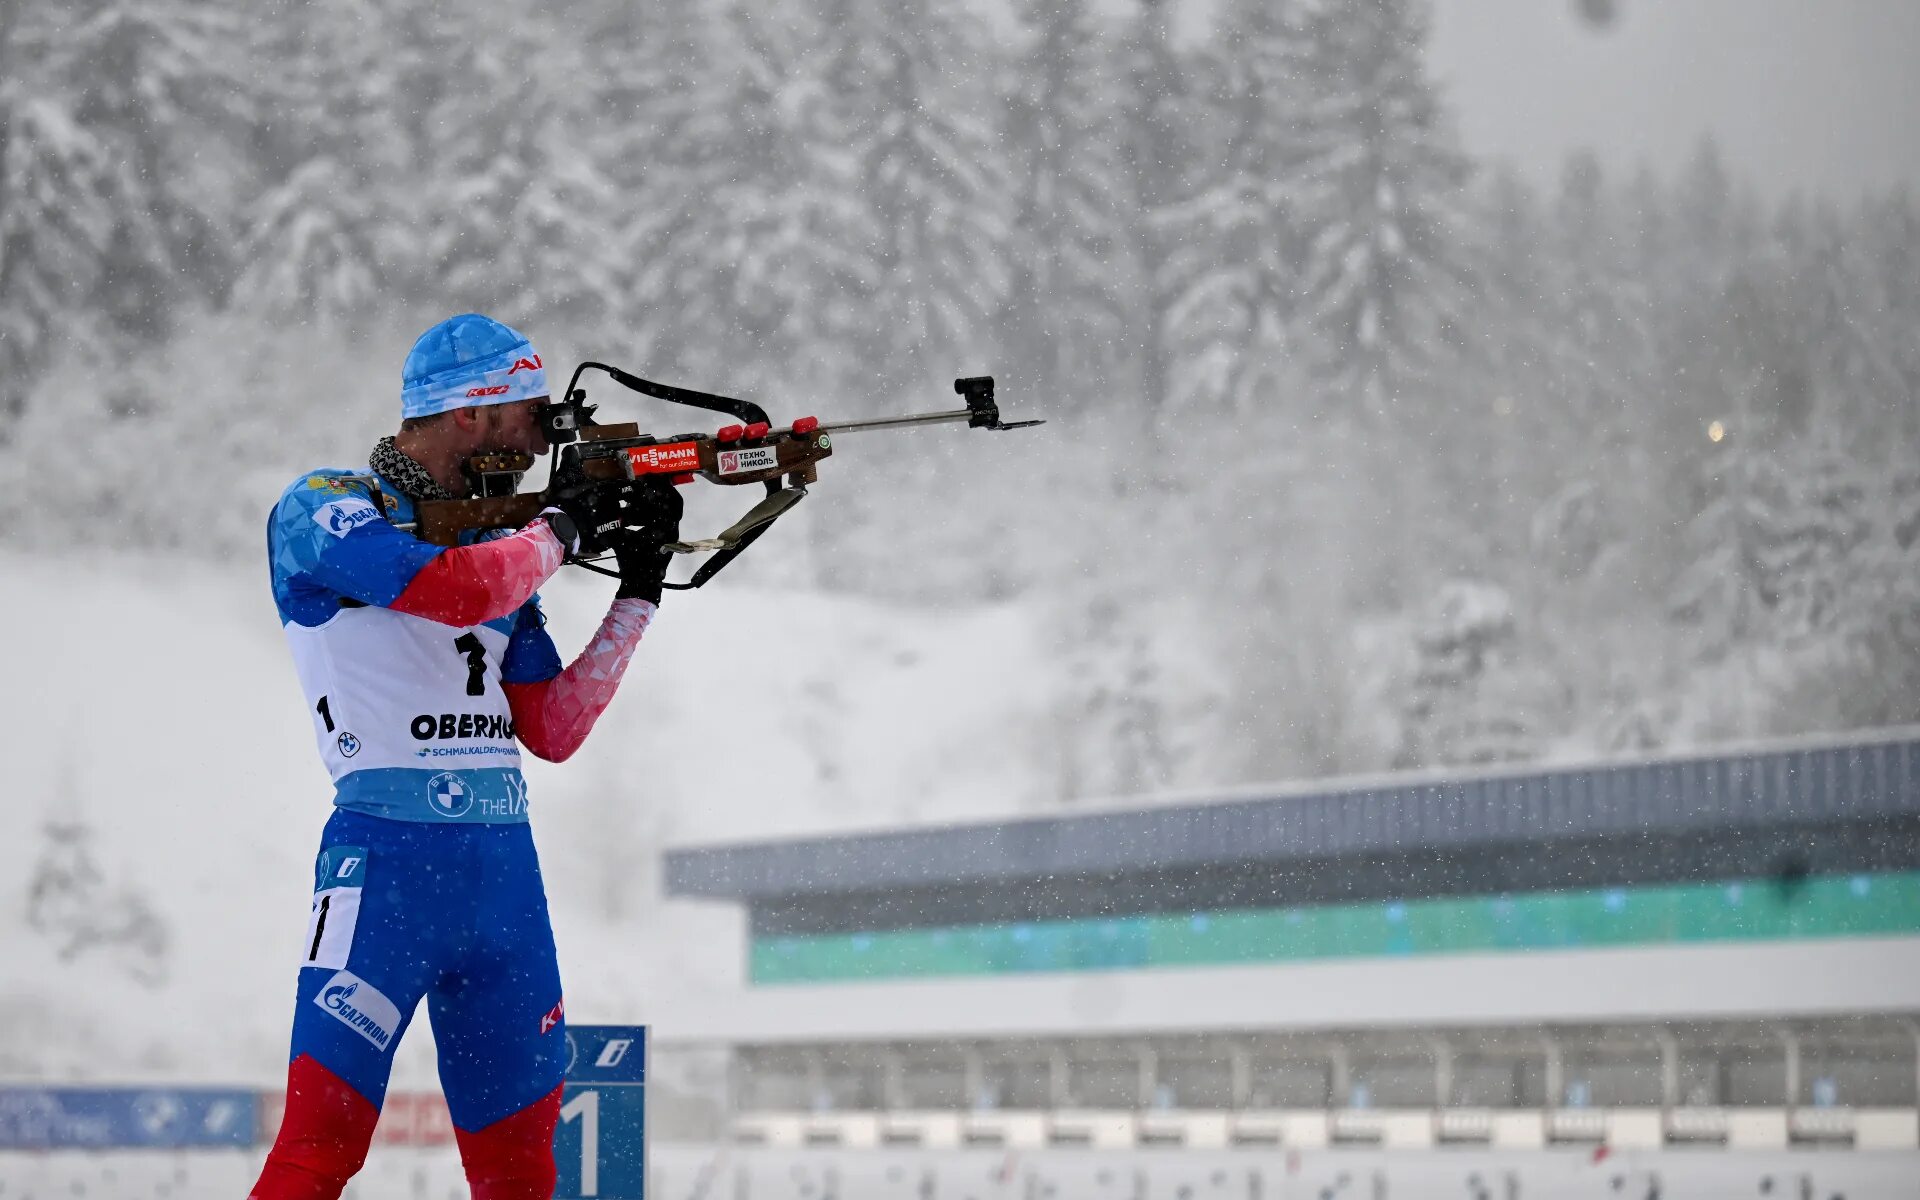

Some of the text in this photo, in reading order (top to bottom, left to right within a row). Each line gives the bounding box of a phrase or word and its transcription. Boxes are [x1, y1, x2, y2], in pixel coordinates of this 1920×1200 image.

[629, 448, 695, 467] VIESSMANN
[738, 450, 766, 460] ТЕХНО
[741, 457, 774, 468] НИКОЛЬ
[351, 507, 381, 522] GAZP
[316, 695, 336, 733] 1
[479, 798, 508, 816] THE
[309, 895, 332, 961] 1
[338, 1004, 390, 1046] GAZPROM
[559, 1090, 599, 1197] 1
